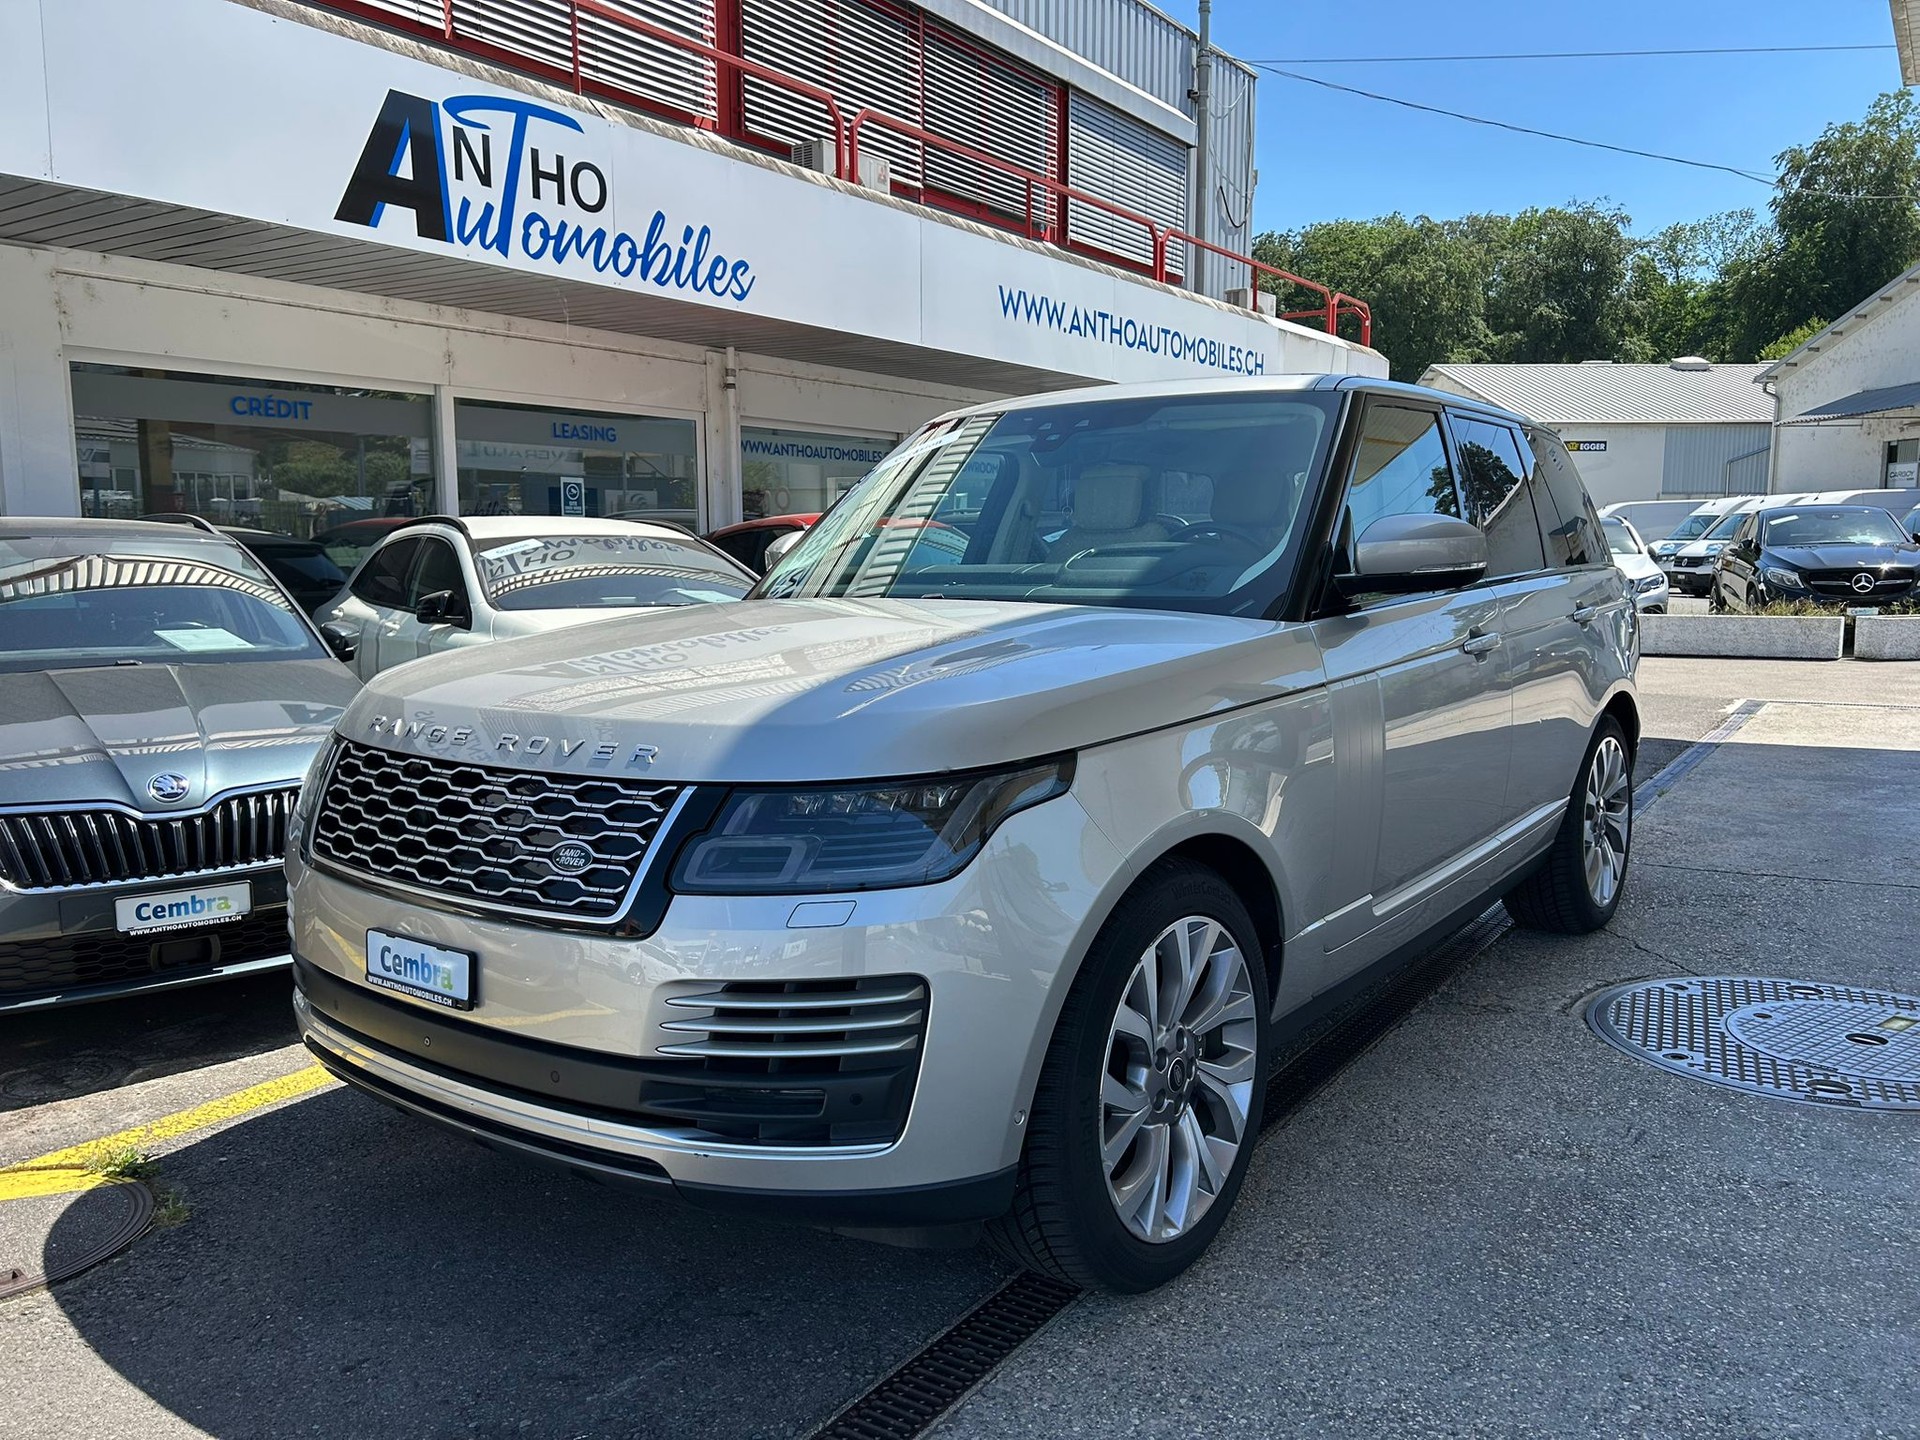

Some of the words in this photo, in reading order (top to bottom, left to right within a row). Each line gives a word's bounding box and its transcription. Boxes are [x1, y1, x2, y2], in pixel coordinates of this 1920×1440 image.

[998, 284, 1264, 376] WWW.ANTHOAUTOMOBILES.CH
[230, 394, 313, 420] CRÉDIT
[552, 421, 617, 443] LEASING
[1580, 443, 1606, 451] EGGER
[368, 714, 473, 746] RANGE
[496, 733, 660, 764] ROVER
[559, 848, 581, 857] LAND
[559, 856, 585, 866] ROVER
[135, 895, 232, 921] Cembra
[129, 915, 242, 936] WWW.ANTHOAUTOMOBILES.CH
[380, 945, 454, 990] Cembra
[367, 974, 453, 1006] WWW.ANTHOAUTOMOBILES.CH
